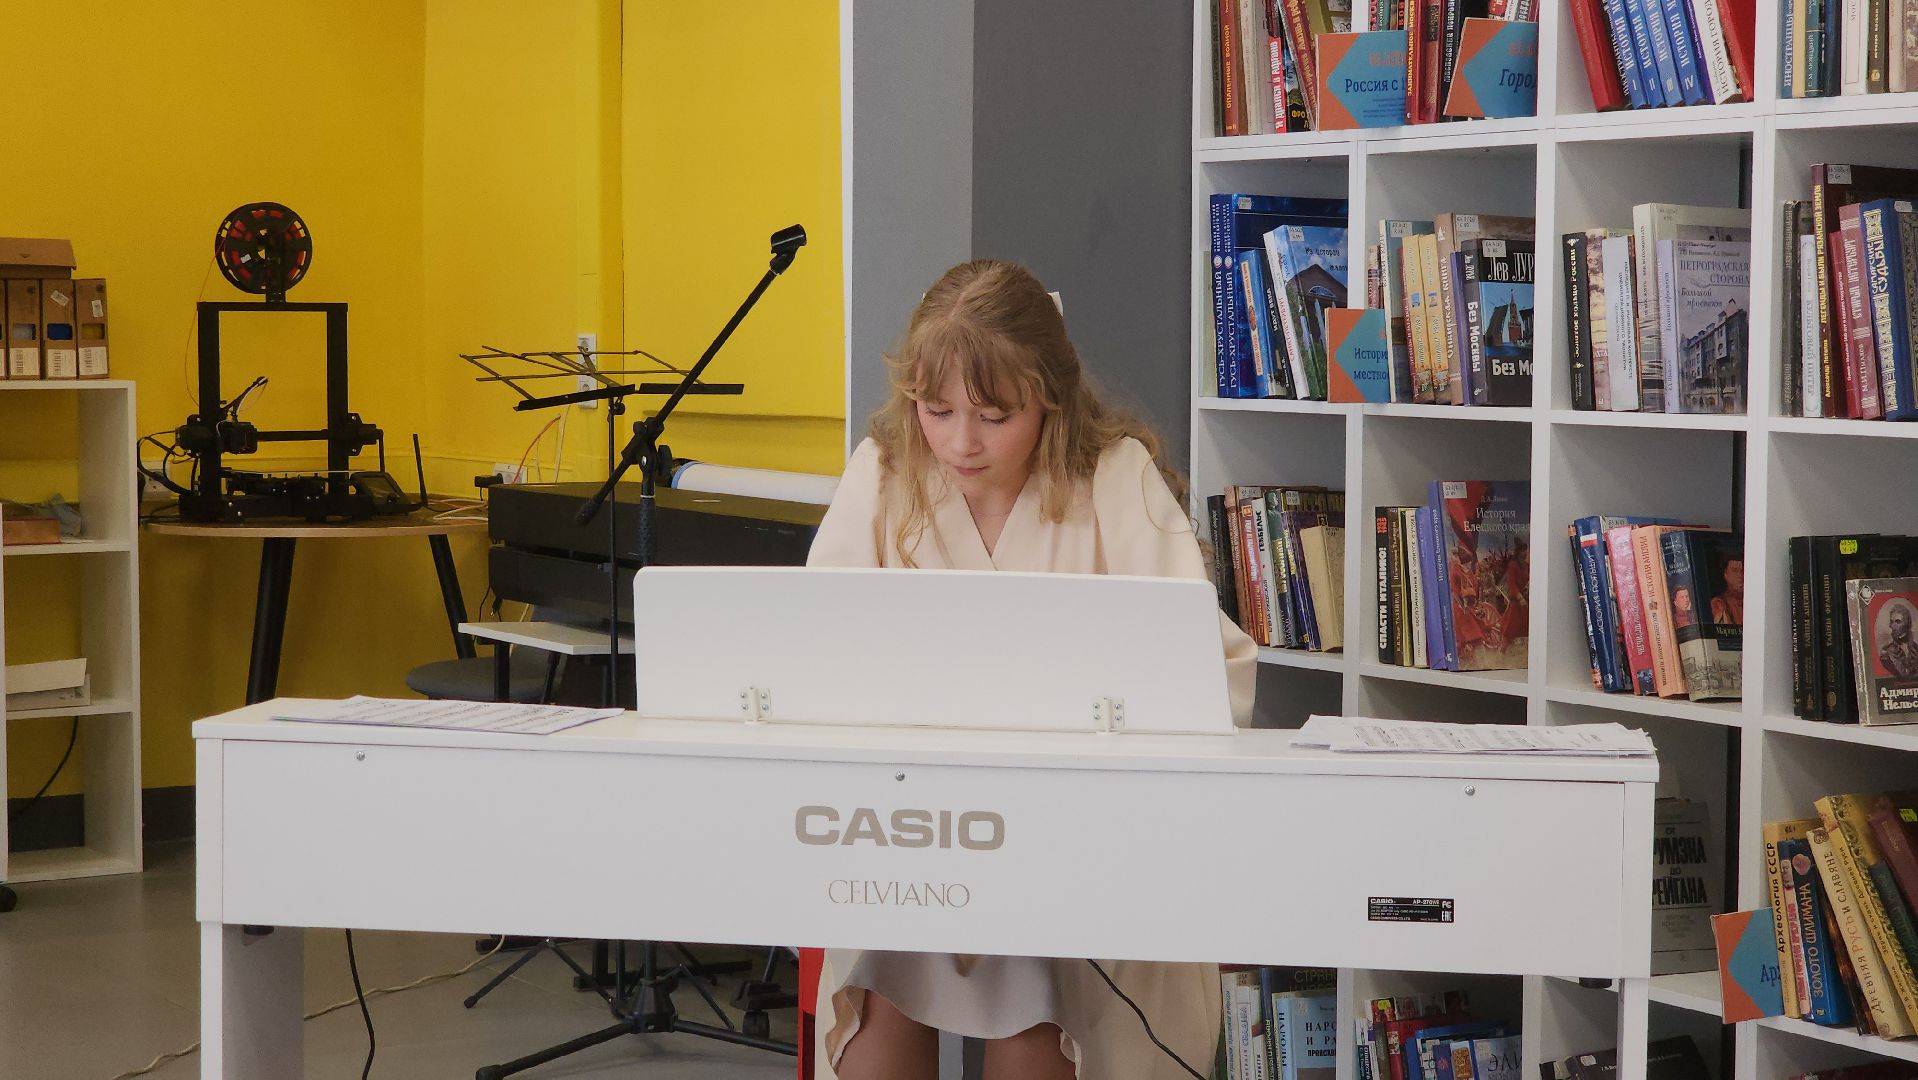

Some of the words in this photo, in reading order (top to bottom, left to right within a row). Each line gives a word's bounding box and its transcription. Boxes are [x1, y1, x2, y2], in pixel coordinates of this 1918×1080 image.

[1614, 16, 1635, 70] ИСТОРИЯ
[1632, 15, 1652, 69] ИСТОРИЯ
[1649, 11, 1668, 62] ИСТОРИЯ
[1669, 13, 1690, 68] ИСТОРИЯ
[1345, 78, 1388, 93] Россия
[1712, 39, 1729, 94] ИСТОРИЯ
[1814, 184, 1823, 210] ЗЕМЛИ
[1815, 211, 1825, 255] РЯЗАНСКОЙ
[1487, 253, 1509, 281] Лев
[1511, 252, 1535, 282] ЛУР
[1680, 259, 1749, 273] ПЕТРОГРАДСКАЯ
[1818, 256, 1826, 279] БЫЛИ
[1867, 241, 1878, 295] САМАРСКИЕ
[1874, 240, 1889, 292] СУДЬБЫ
[1468, 301, 1479, 323] Без
[1819, 287, 1828, 323] ЛЕГЕНДЫ
[1214, 271, 1226, 387] ГУСЬ-ХРУСТАЛЬНЫЙ
[1226, 271, 1237, 389] ГУСЬ-ХРУСТАЛЬНЫЙ
[1470, 325, 1482, 373] Москвы
[1354, 370, 1388, 380] местно
[1492, 358, 1516, 376] Без
[1255, 510, 1265, 552] ГЕББЕЛЬС
[1475, 507, 1517, 522] История
[1378, 547, 1387, 602] ИТАЛИЮ!
[1379, 605, 1388, 650] СПАСТИ
[795, 805, 1005, 850] CASIO
[1654, 837, 1707, 865] УМЭНА
[1766, 842, 1778, 875] СССР
[828, 879, 970, 908] CELVIANO
[1823, 851, 1848, 903] СЛАВЯНЕ
[1770, 876, 1785, 954] Археология
[1799, 882, 1817, 944] ШЛИМАНА
[1845, 915, 1866, 952] РУСЬ
[1806, 946, 1823, 998] ЗОЛОТО
[1858, 954, 1885, 1014] ДРЕВНЯЯ
